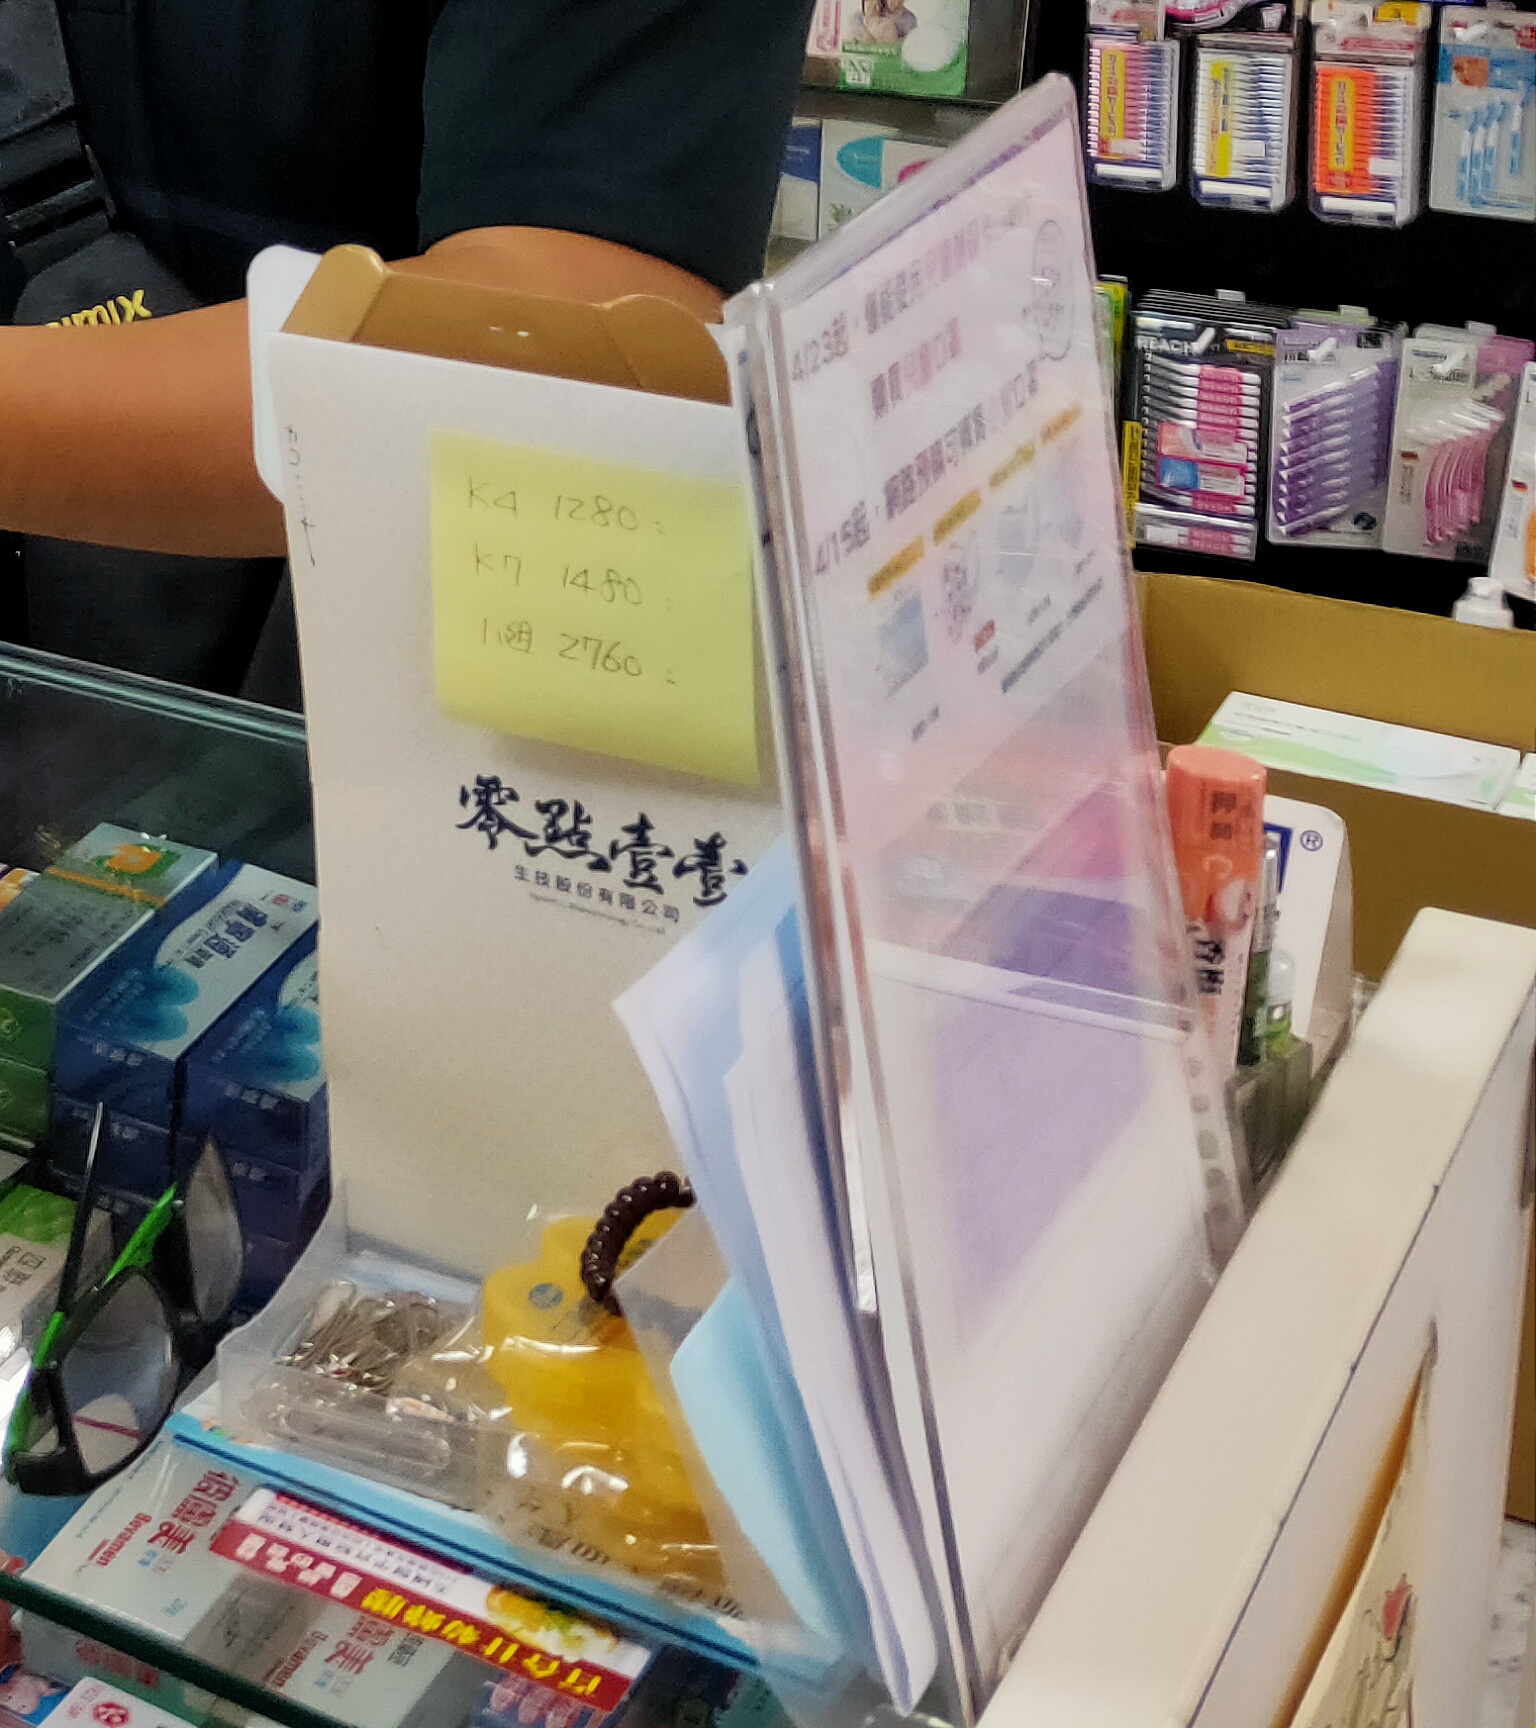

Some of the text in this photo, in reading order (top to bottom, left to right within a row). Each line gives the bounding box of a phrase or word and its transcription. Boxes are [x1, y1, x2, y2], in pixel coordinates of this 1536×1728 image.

[554, 494, 640, 533] 1280
[562, 566, 644, 607] 1480
[558, 631, 643, 677] 2760
